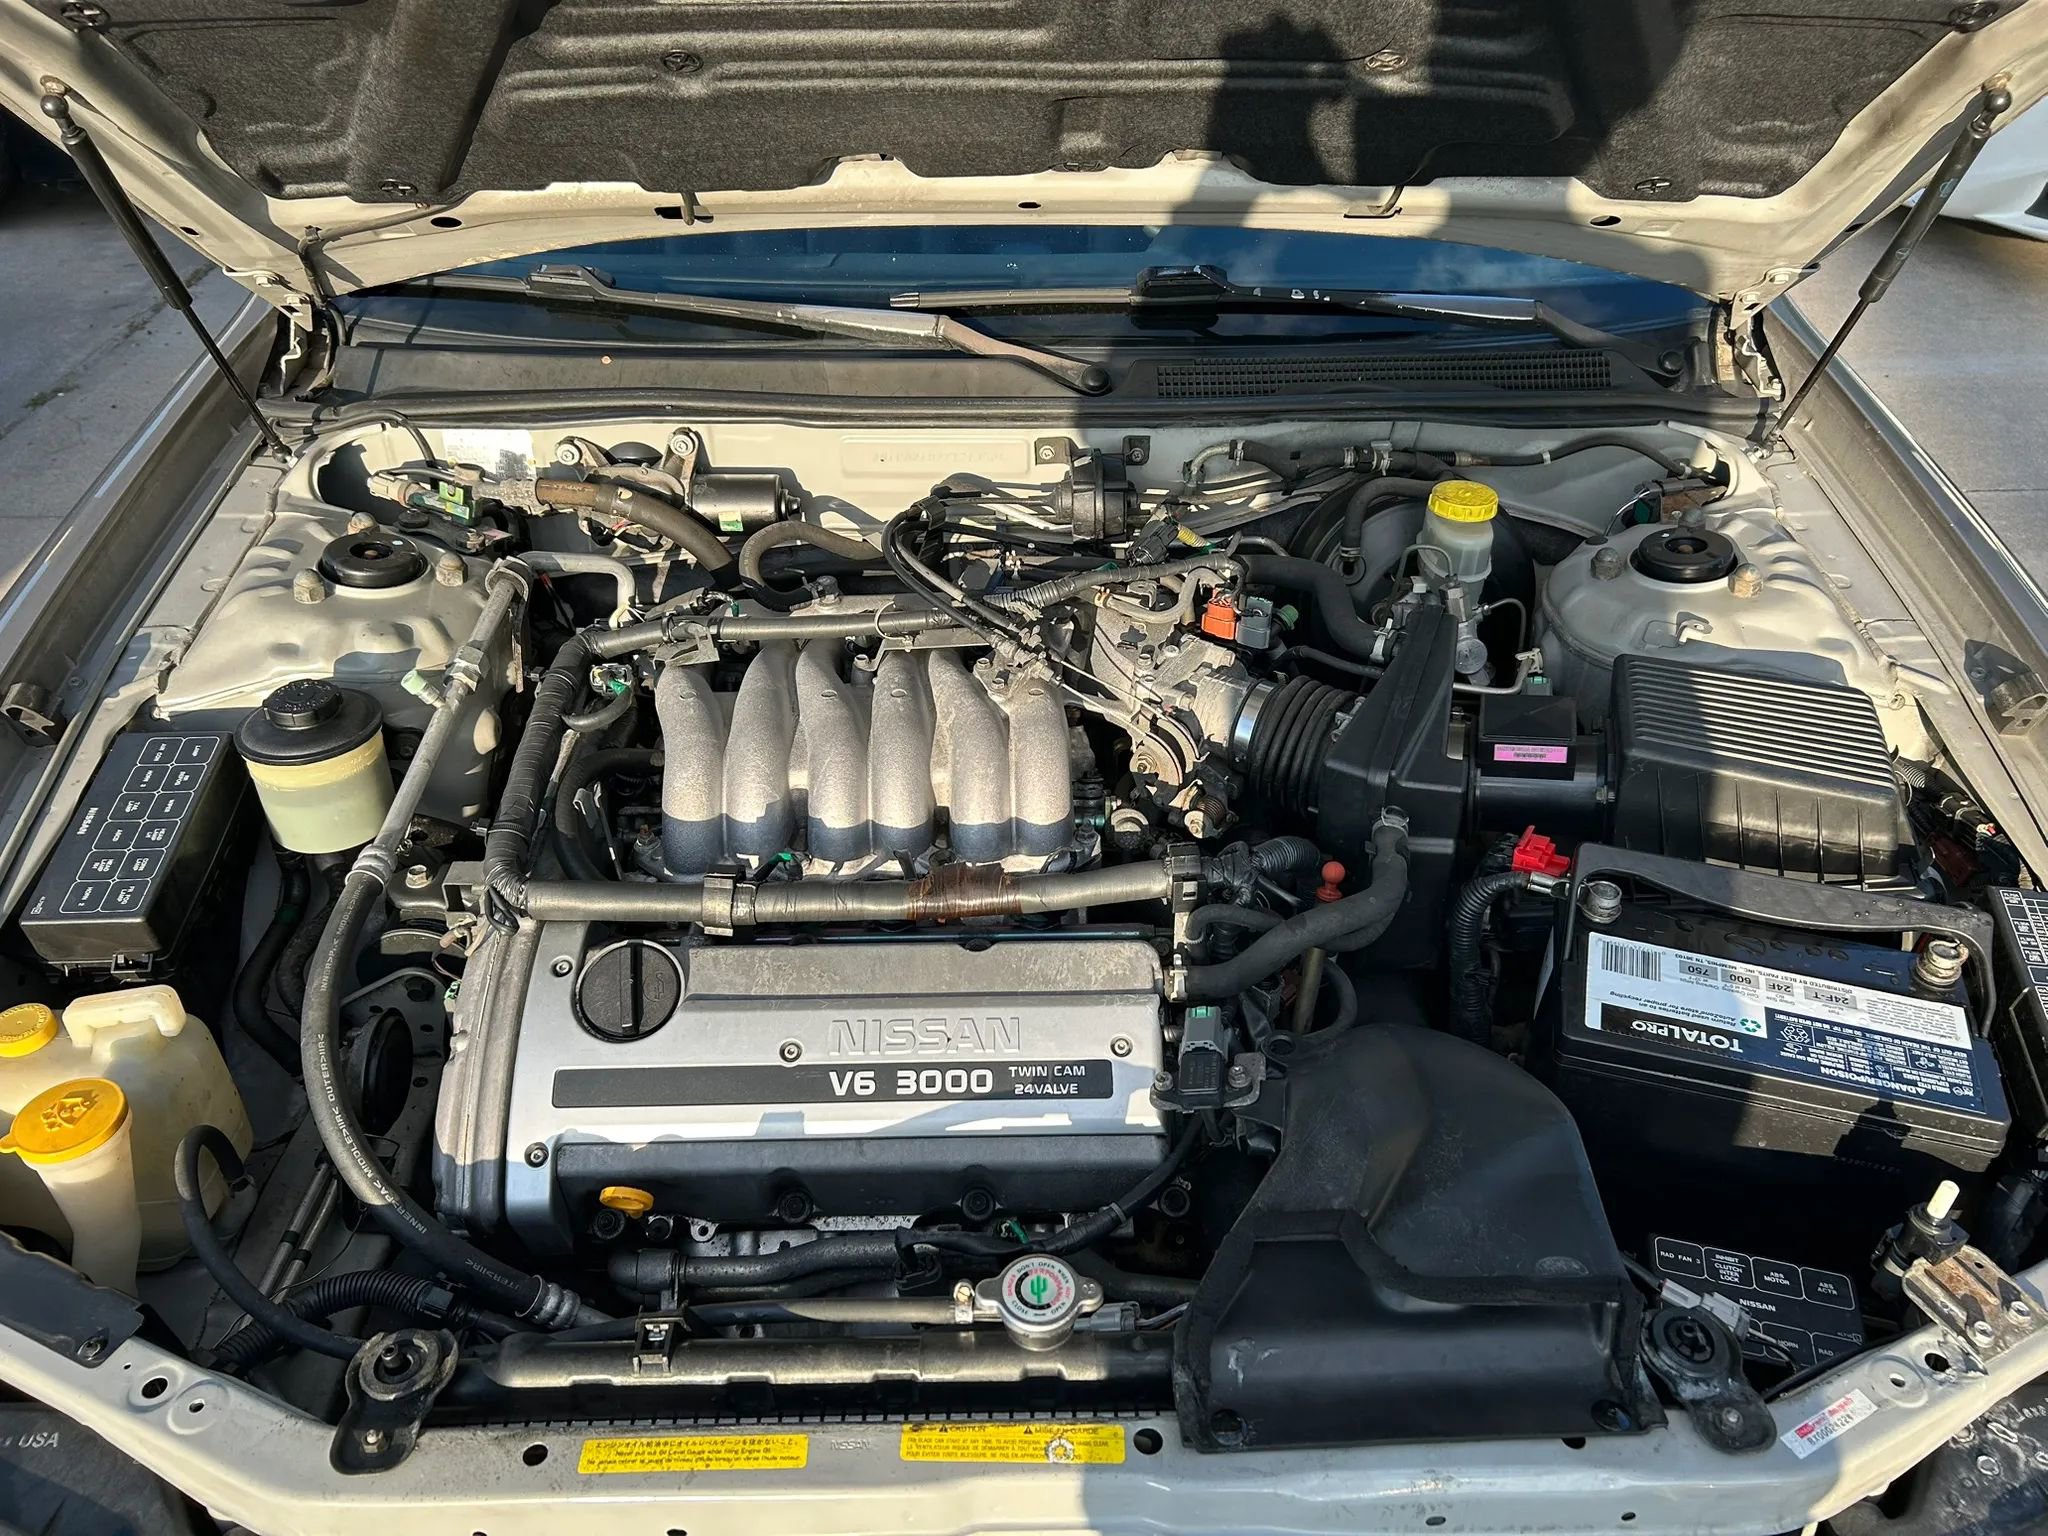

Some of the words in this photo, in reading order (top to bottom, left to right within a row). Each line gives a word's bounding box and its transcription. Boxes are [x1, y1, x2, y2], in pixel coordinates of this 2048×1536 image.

[154, 752, 162, 761] CON
[143, 770, 152, 781] HORN
[77, 808, 98, 834] NISSAN
[151, 829, 159, 840] LAMP
[157, 828, 166, 840] HEAD
[97, 859, 107, 871] LAMP
[103, 859, 113, 871] HEAD
[133, 858, 142, 870] LAMP
[82, 887, 92, 900] HORN
[117, 889, 126, 901] LAMP
[1688, 966, 1709, 976] 750
[1729, 974, 1751, 984] 600
[1768, 983, 1790, 992] 24F
[1809, 982, 1852, 993] DISTRIBUTED
[1610, 991, 1641, 1001] recycling
[1813, 992, 1848, 1004] 24F-T
[1658, 1007, 1689, 1016] batteries
[1711, 1018, 1735, 1026] Return
[829, 1017, 1019, 1056] NISSAN
[1632, 1020, 1742, 1052] TOTALPRO
[1008, 1066, 1048, 1077] TWIN
[1054, 1065, 1086, 1076] CAM
[829, 1070, 876, 1096] V6
[896, 1069, 993, 1095] 3000
[1820, 1068, 1916, 1093] DANGER/POISON
[1014, 1084, 1078, 1094] 24VALVE
[1660, 1250, 1675, 1259] RAD
[1678, 1255, 1693, 1264] FAN
[1016, 1262, 1034, 1274] DON'T
[1038, 1262, 1056, 1270] OPEN
[1714, 1262, 1743, 1274] CLUTCH
[1719, 1270, 1740, 1278] INTER
[1720, 1274, 1740, 1284] LOCK
[1764, 1276, 1790, 1286] MOTOR
[1817, 1286, 1838, 1296] ACTR
[1819, 1282, 1835, 1290] ABS
[1012, 1300, 1028, 1315] CLOSE
[1050, 1302, 1066, 1314] OPEN
[1739, 1298, 1776, 1312] NISSAN
[1777, 1338, 1799, 1350] HORN
[1818, 1348, 1835, 1357] RAD
[18, 1432, 59, 1448] USA
[831, 1439, 871, 1450] NISSAN
